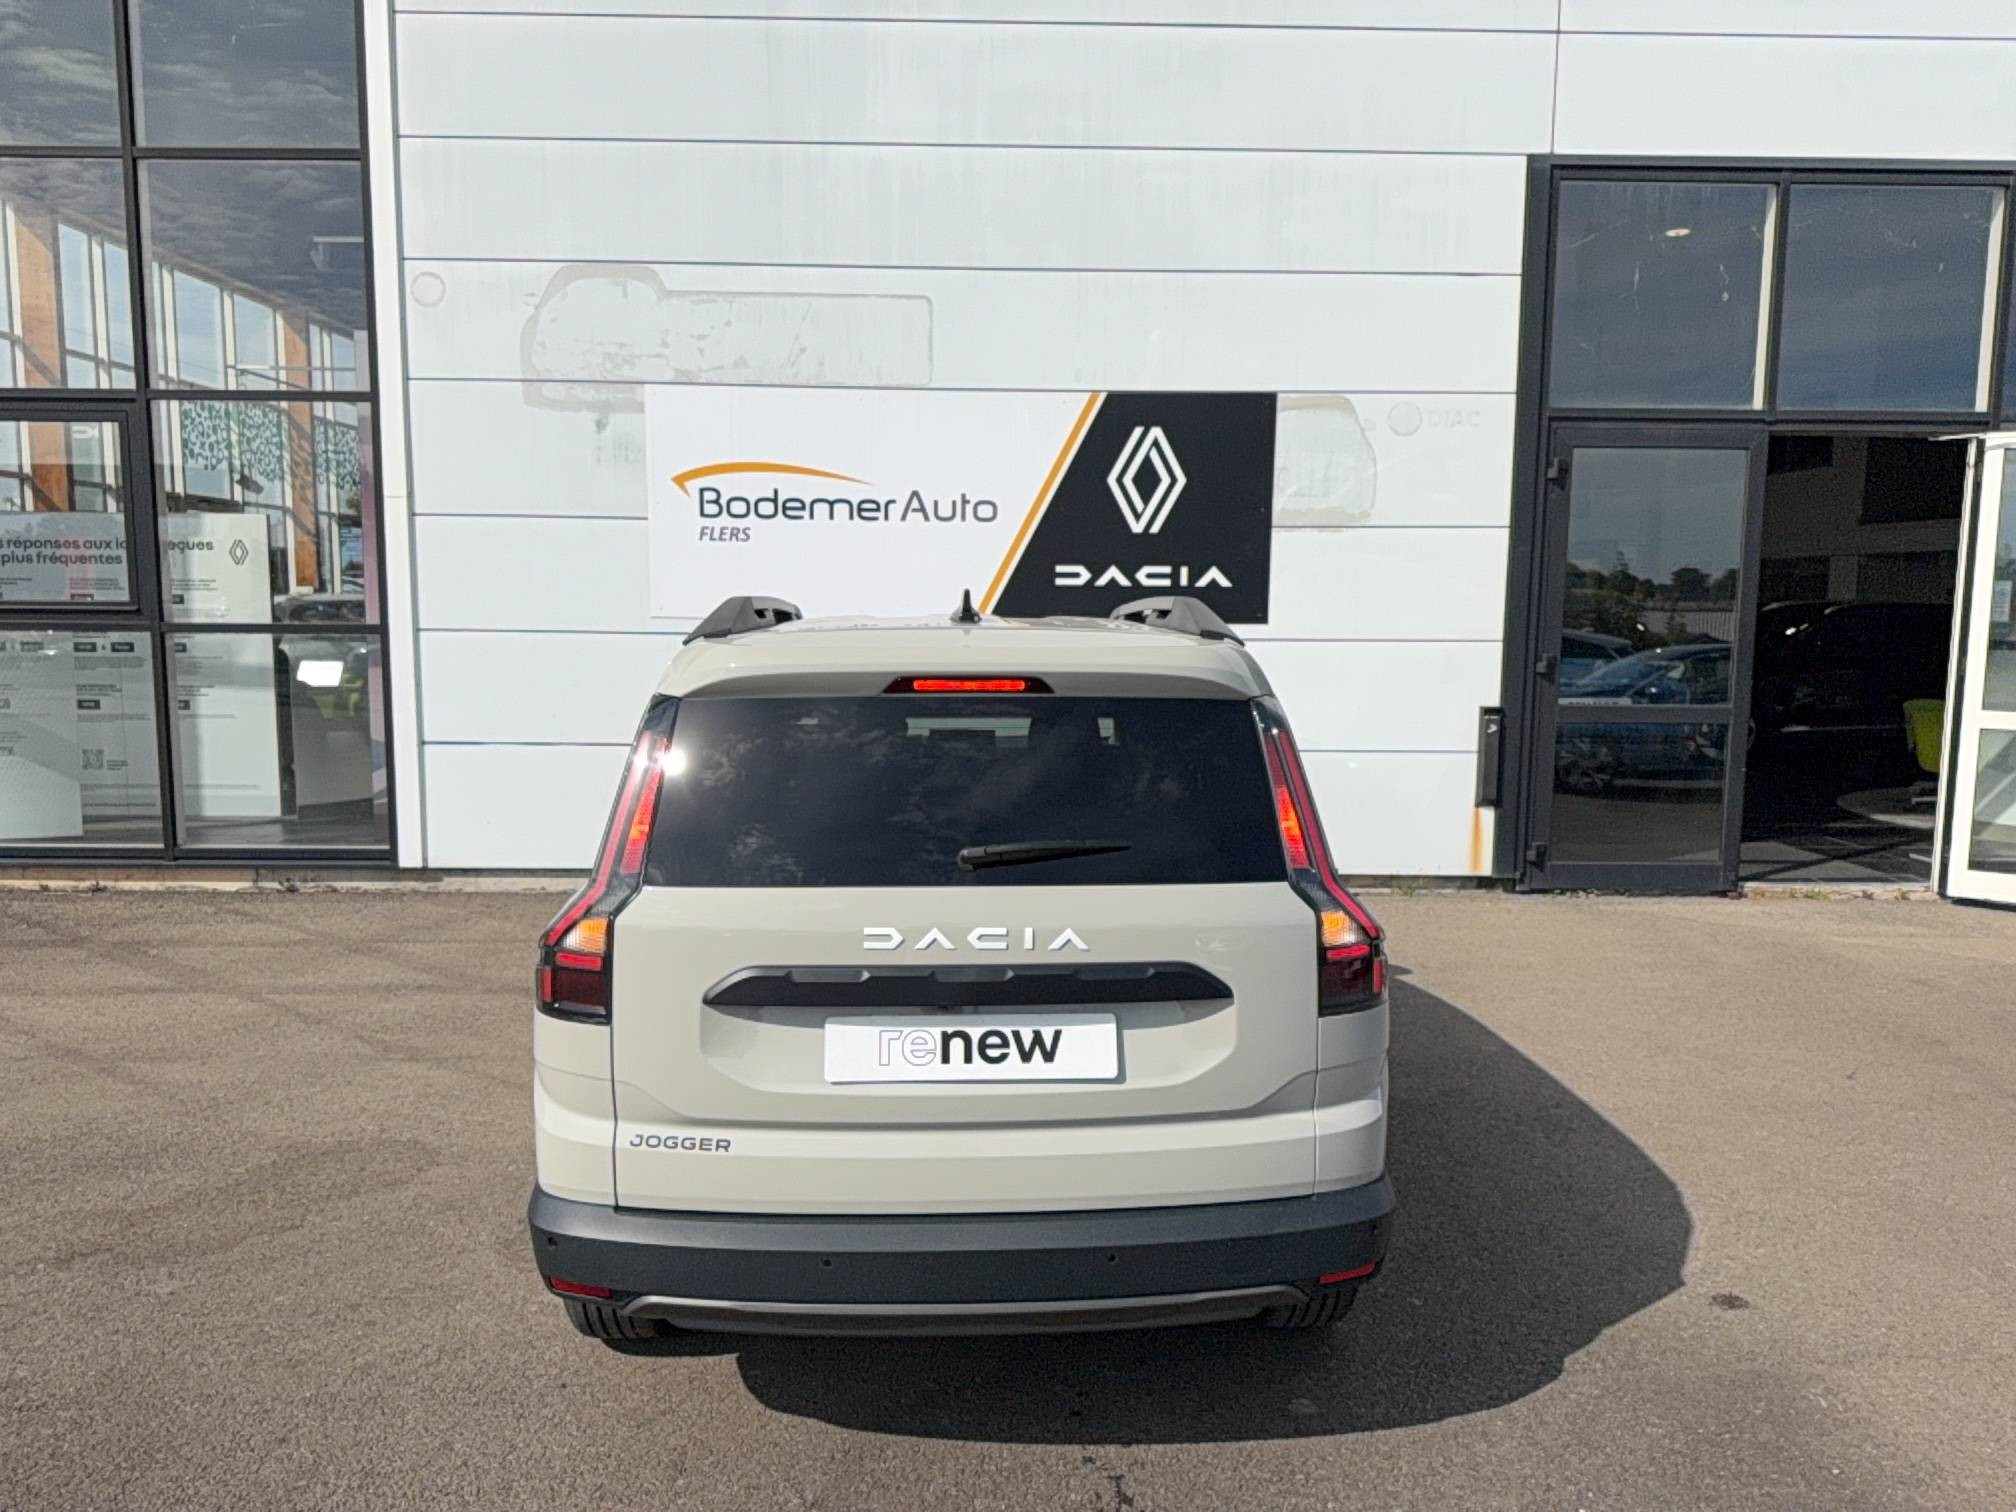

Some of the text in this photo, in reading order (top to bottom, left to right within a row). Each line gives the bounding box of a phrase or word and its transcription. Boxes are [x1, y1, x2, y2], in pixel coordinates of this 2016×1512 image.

[699, 526, 751, 542] FLERS
[7, 536, 81, 553] réponses
[83, 539, 113, 550] aux
[167, 540, 214, 554] eçues
[1, 550, 123, 567] plus fréquentes
[1054, 564, 1233, 588] DACIA
[863, 927, 1089, 951] DACIA
[877, 1028, 1063, 1067] renew
[629, 1133, 732, 1153] JOGGER
